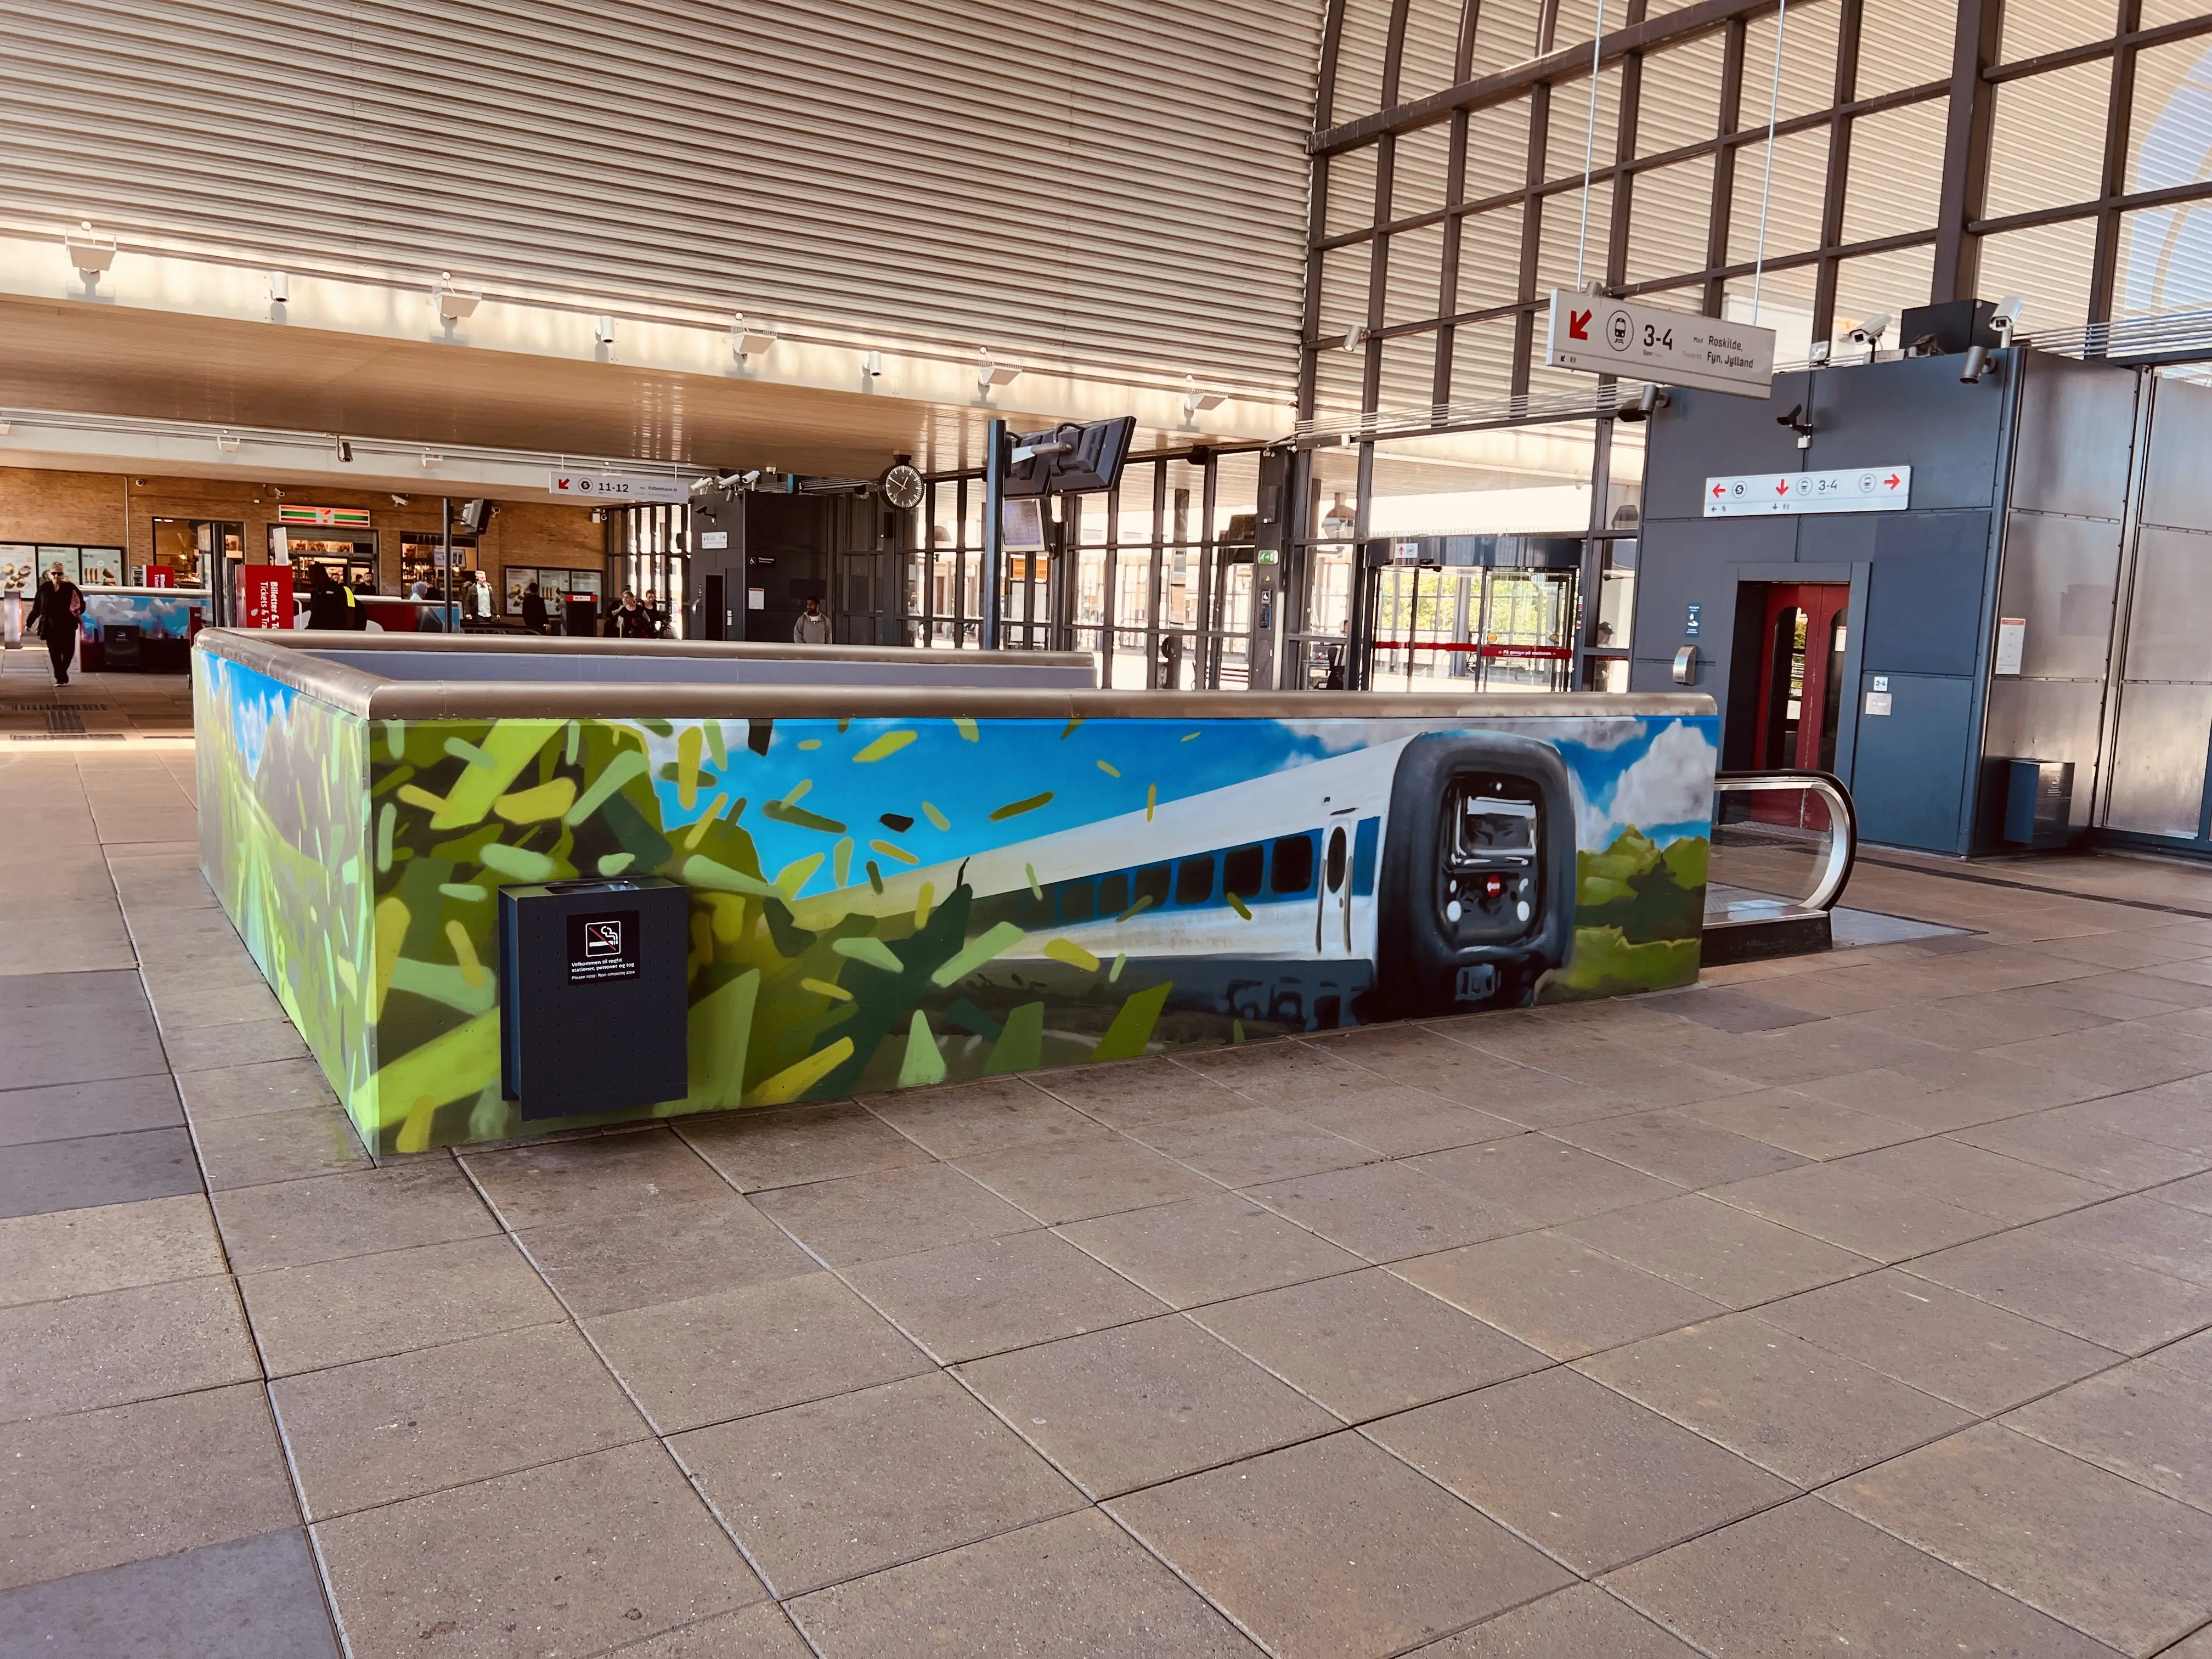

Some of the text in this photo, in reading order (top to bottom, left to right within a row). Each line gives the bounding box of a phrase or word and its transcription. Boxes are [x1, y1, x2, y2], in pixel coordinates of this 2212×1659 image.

[1644, 324, 1673, 350] 3-4
[1708, 336, 1743, 352] Roskilde,
[1707, 351, 1753, 368] Fyn, Jylland
[599, 482, 629, 493] 11-12
[1819, 479, 1837, 490] 3-4
[260, 582, 268, 607] Tickets
[270, 582, 279, 613] Billetter
